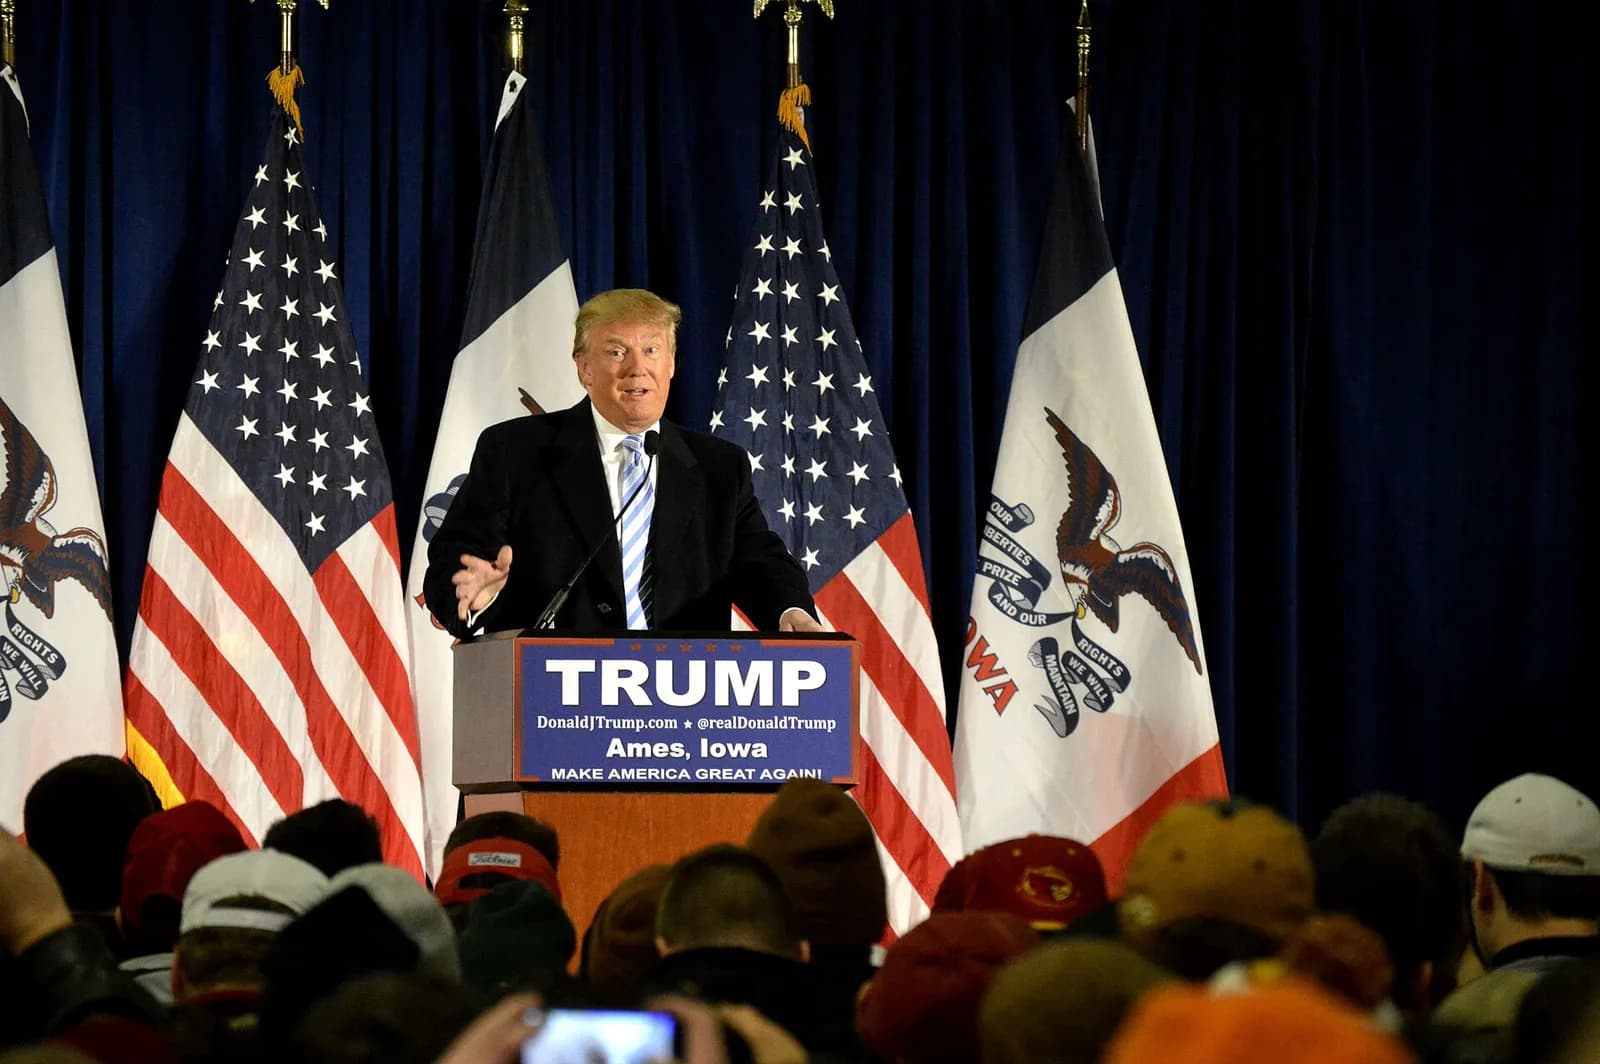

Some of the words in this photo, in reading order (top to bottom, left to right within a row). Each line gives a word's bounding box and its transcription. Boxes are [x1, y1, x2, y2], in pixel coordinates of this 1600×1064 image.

[991, 502, 1013, 525] OUR
[982, 561, 1021, 585] PRIZE
[993, 592, 1018, 617] AND
[1020, 613, 1047, 624] OUR
[11, 623, 59, 664] RIGHTS
[1077, 638, 1124, 677] RIGHTS
[2, 642, 20, 661] WE
[19, 660, 42, 690] WILL
[546, 659, 827, 707] TRUMP
[1068, 657, 1087, 676] WE
[1086, 674, 1108, 703] WILL
[1045, 654, 1077, 716] MAINTAIN
[537, 715, 678, 732] DonaldJTrump.com
[697, 716, 836, 733] @realDonaldTrump
[606, 738, 691, 760] Ames,
[701, 738, 768, 758] Iowa
[552, 768, 604, 780] MAKE
[608, 768, 691, 780] AMERICA
[695, 768, 756, 780] GREAT
[760, 768, 822, 780] AGAIN!
